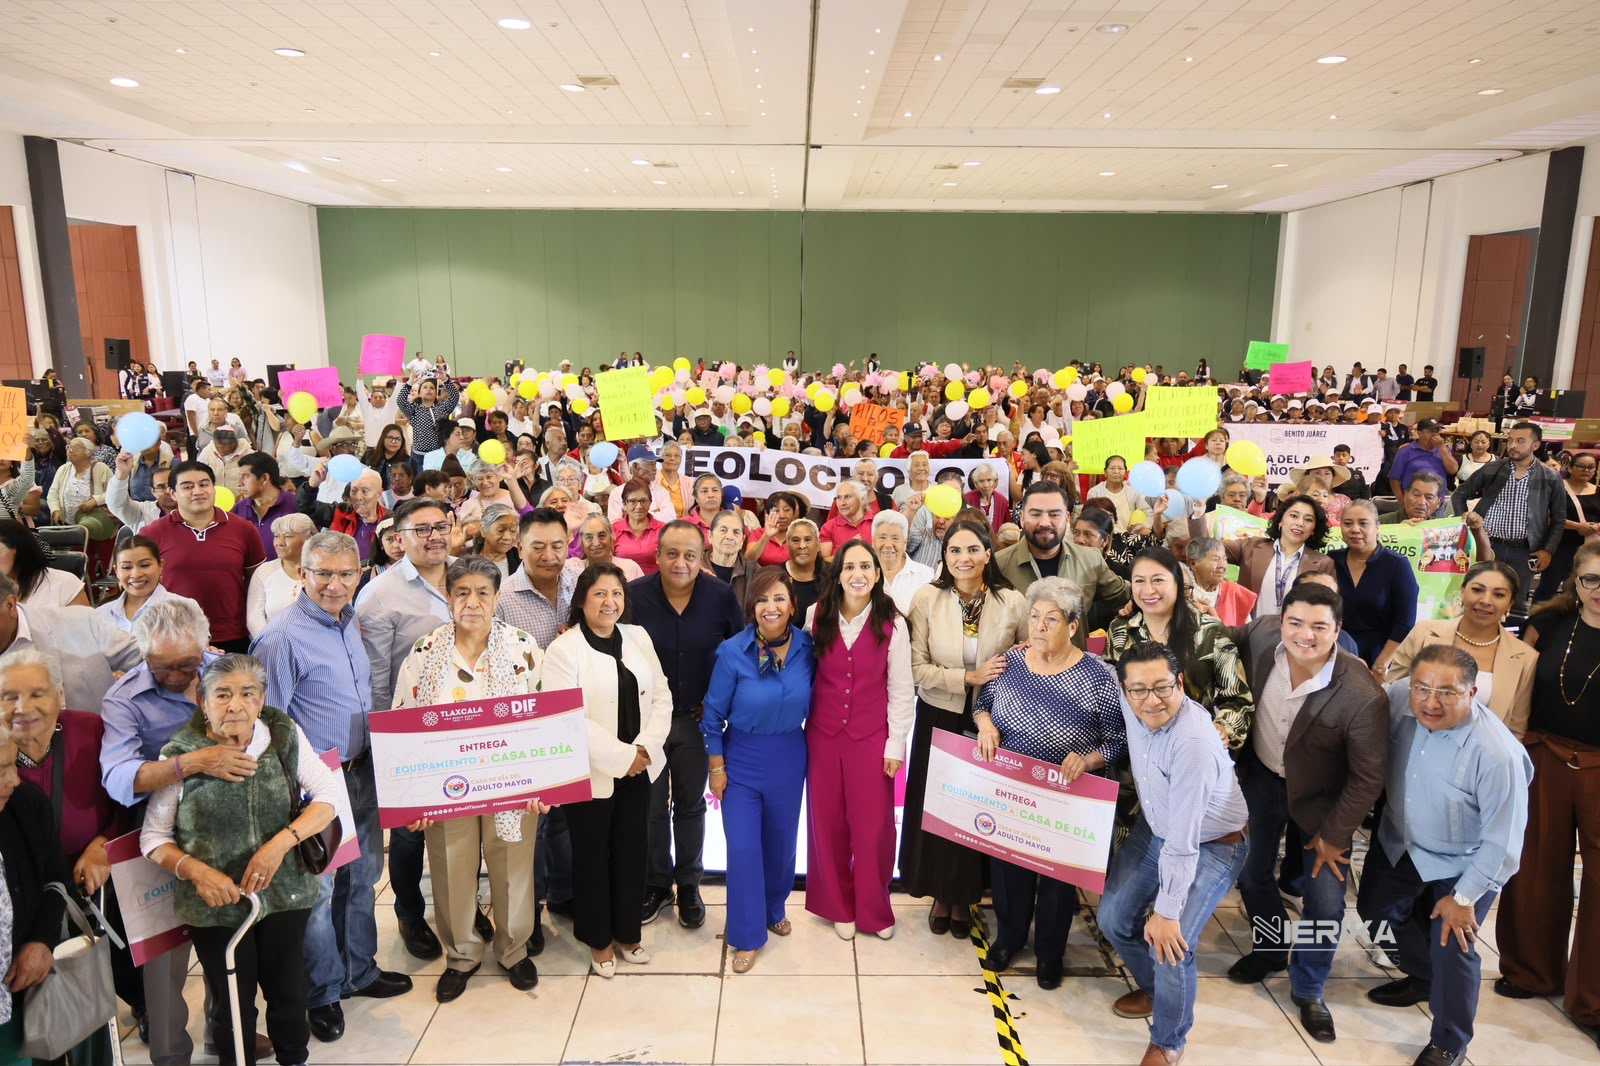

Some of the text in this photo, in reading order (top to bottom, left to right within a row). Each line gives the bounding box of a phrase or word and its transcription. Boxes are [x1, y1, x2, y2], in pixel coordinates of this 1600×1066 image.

[1285, 430, 1305, 438] BENITO
[1278, 455, 1299, 464] DEL
[440, 706, 484, 717] TLAXCALA
[511, 698, 537, 714] DIF
[459, 738, 508, 753] ENTREGA
[395, 756, 478, 776] EQUIPAMIENTO
[490, 750, 526, 763] CASA
[530, 747, 548, 758] DE
[550, 741, 573, 755] DÍA
[993, 754, 1023, 768] AXCALA
[472, 778, 532, 793] ADULTO MAYOR
[995, 788, 1038, 809] ENTREGA
[942, 783, 1008, 812] EQUIPAMIENTO
[1019, 810, 1051, 827] CASA
[1055, 821, 1071, 833] DE
[1073, 824, 1096, 842] DÍA
[997, 831, 1025, 845] ADULTO
[1025, 840, 1051, 853] MAYOR
